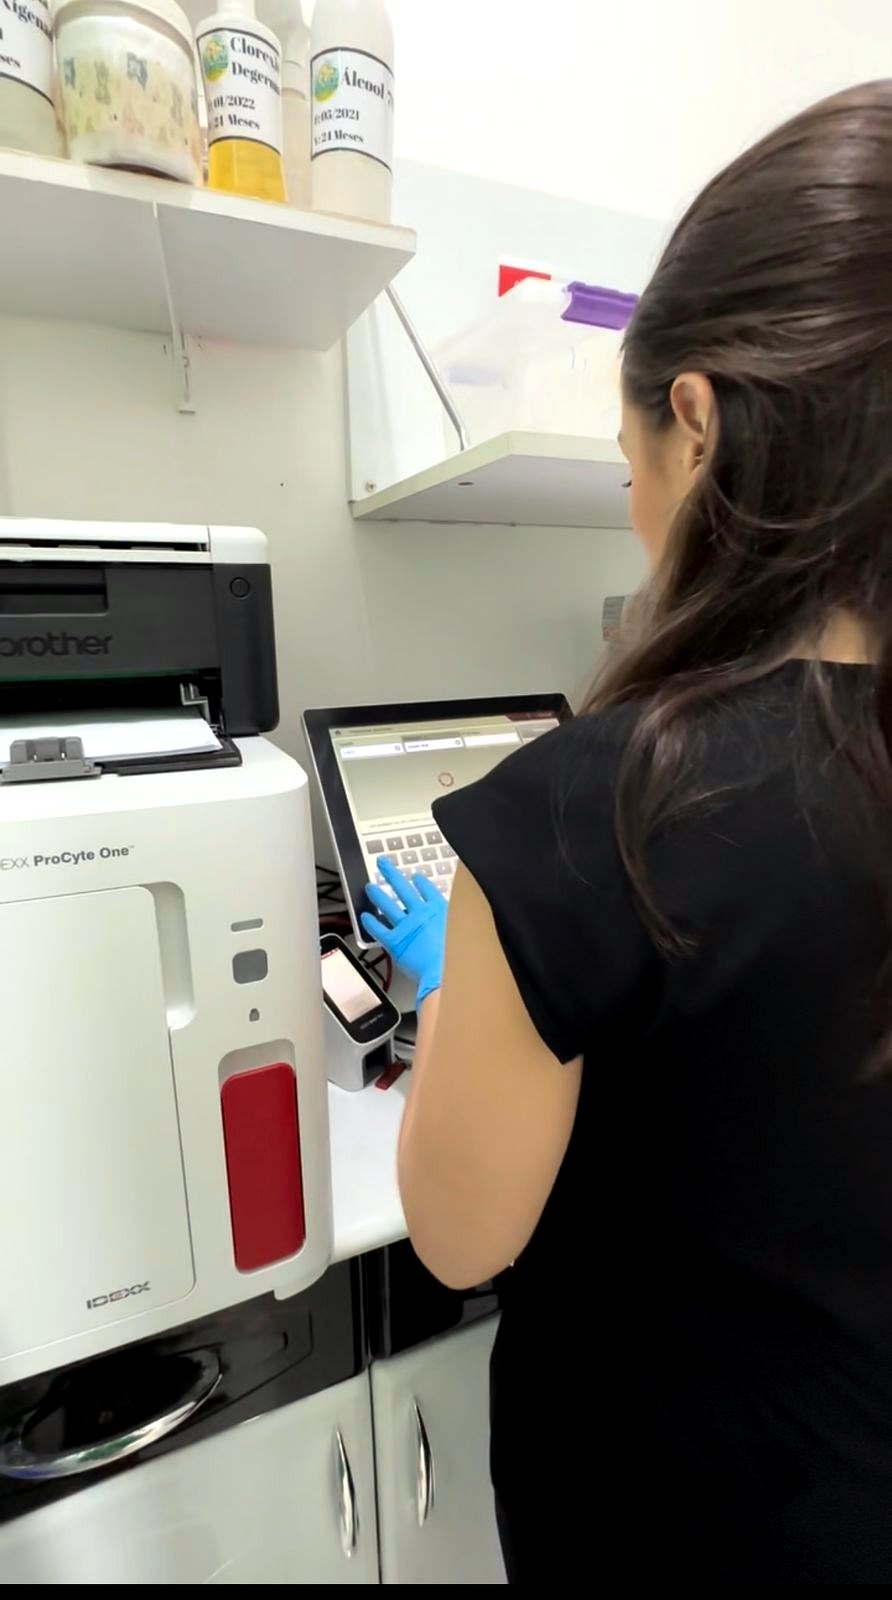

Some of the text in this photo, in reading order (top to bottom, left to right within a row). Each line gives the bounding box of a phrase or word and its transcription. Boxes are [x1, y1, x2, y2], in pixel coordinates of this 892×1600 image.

[0, 54, 21, 68] ses
[342, 66, 385, 100] Álcool
[0, 857, 29, 870] EXX
[33, 850, 95, 866] ProCyte
[86, 1280, 151, 1310] IDEXX
